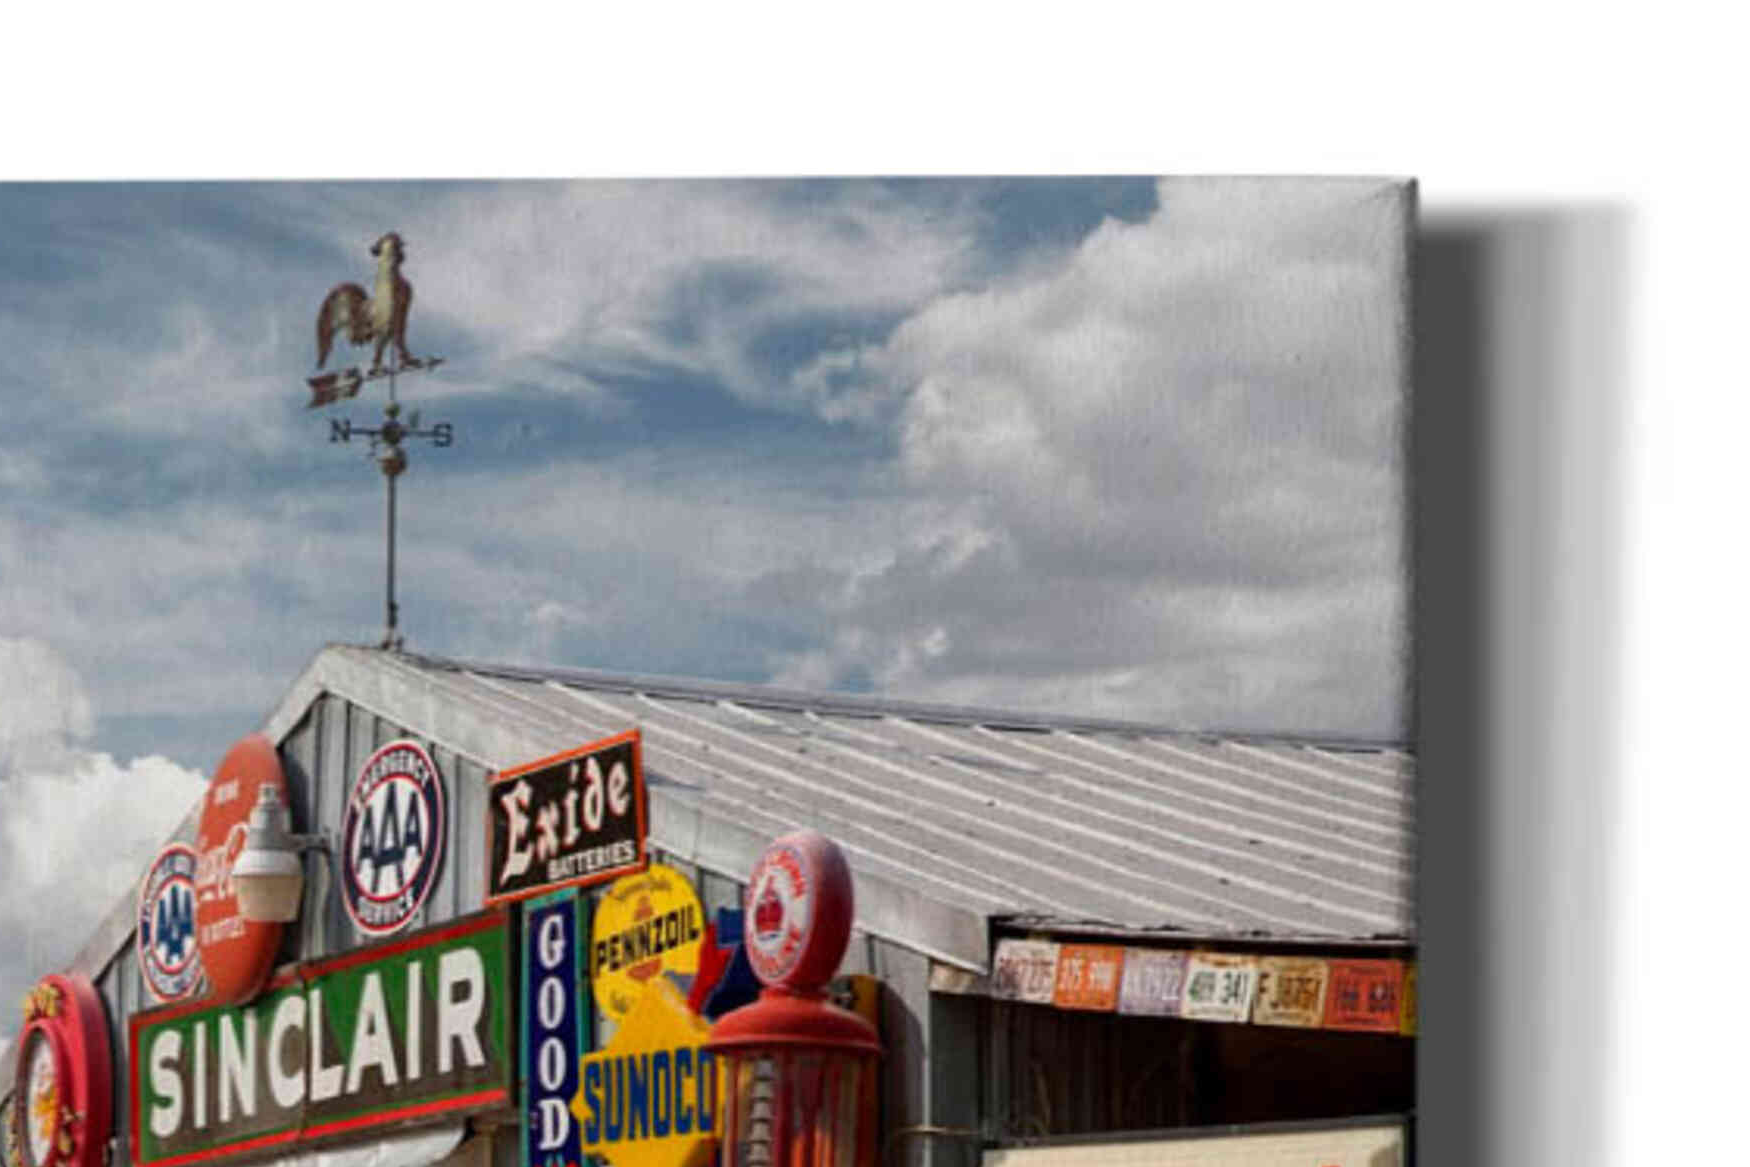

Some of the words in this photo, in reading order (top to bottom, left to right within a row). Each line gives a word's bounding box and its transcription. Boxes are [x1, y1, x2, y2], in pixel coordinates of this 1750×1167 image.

[330, 420, 351, 443] N
[433, 424, 453, 447] S
[355, 781, 424, 893] AAA
[499, 756, 631, 887] Exide
[547, 841, 636, 881] BATTERIES
[155, 884, 194, 959] AAA
[595, 904, 700, 977] PENNZOIL
[150, 946, 485, 1138] SINCLAIR
[583, 1045, 717, 1145] SUNOCO
